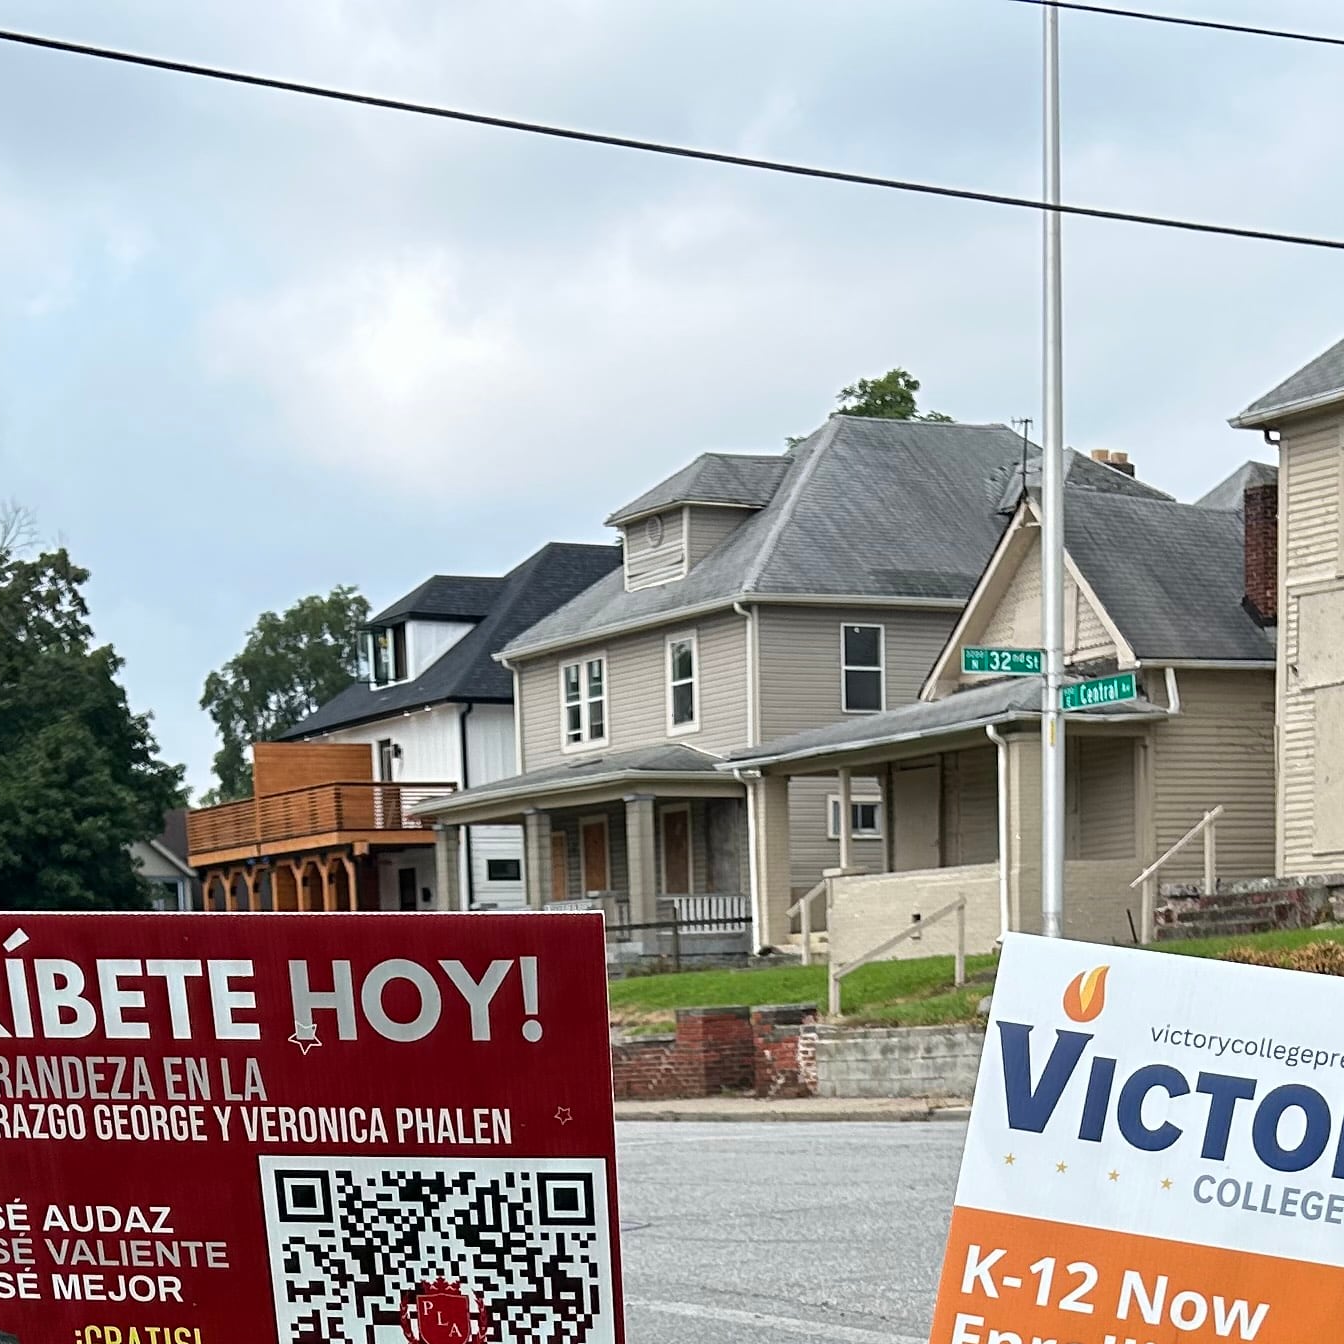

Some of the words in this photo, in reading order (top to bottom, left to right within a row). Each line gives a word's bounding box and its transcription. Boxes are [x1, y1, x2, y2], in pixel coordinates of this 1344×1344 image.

[1025, 655, 1039, 669] St
[1080, 679, 1119, 705] Central
[289, 956, 543, 1043] HOY!
[163, 1056, 211, 1100] EN
[220, 1058, 267, 1101] LA
[94, 1104, 207, 1141] GEORGE
[212, 1106, 232, 1141] Y
[240, 1106, 389, 1143] VERONICA
[396, 1108, 512, 1144] PHALEN
[43, 1205, 174, 1233] AUDAZ
[44, 1238, 230, 1268] VALIENTE
[52, 1274, 183, 1302] MEJOR
[960, 1244, 1099, 1314] K-12
[1116, 1270, 1270, 1342] Now
